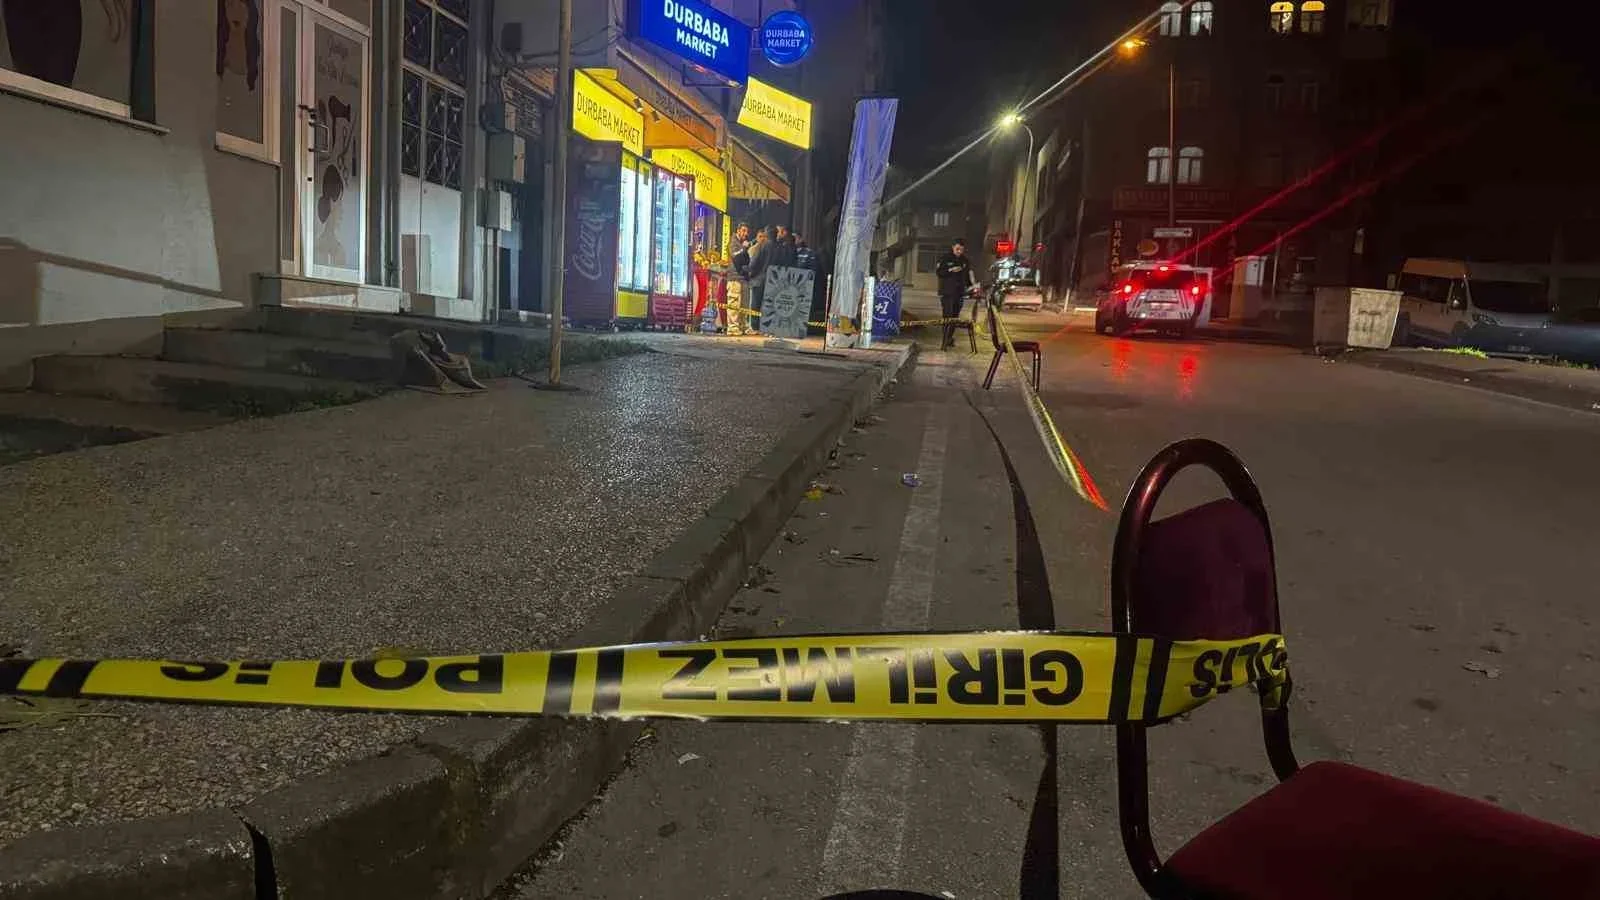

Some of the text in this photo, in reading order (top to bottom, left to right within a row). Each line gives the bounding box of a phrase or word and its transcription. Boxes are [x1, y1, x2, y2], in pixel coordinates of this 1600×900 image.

[663, 0, 730, 47] DURBABA
[765, 29, 805, 39] DURBABA
[676, 28, 718, 59] MARKET
[767, 39, 802, 49] MARKET
[576, 91, 612, 131] DURBABA
[613, 116, 641, 148] MARKET
[777, 111, 806, 134] MARKET
